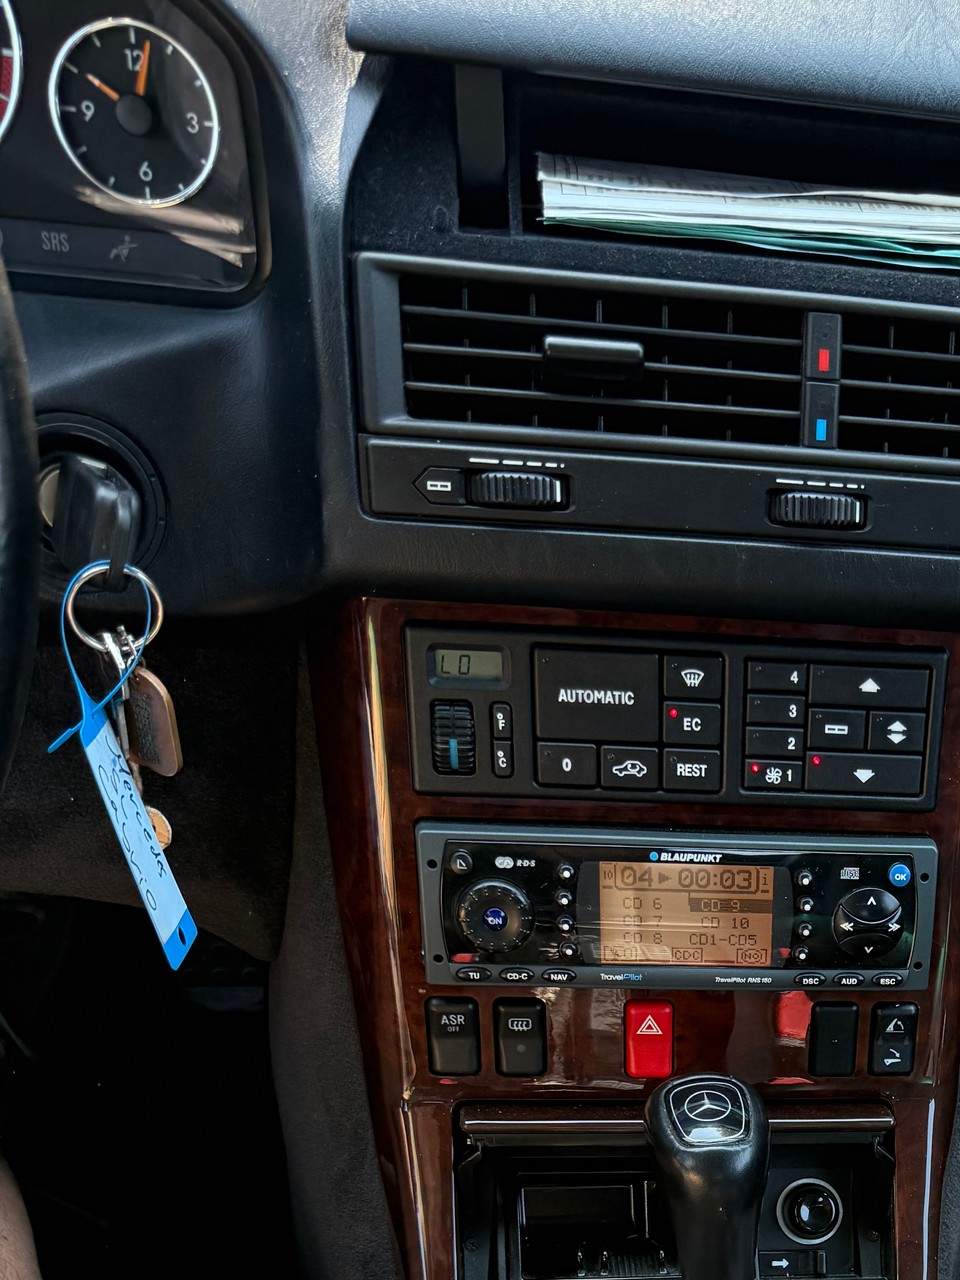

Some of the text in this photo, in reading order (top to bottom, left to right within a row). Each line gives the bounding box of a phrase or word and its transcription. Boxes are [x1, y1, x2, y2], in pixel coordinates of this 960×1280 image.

[124, 49, 144, 71] 12
[81, 100, 95, 122] 9
[186, 112, 200, 134] 3
[139, 161, 152, 182] 6
[42, 231, 70, 252] SRS
[790, 671, 798, 684] 4
[558, 689, 635, 706] AUTOMATIC
[789, 704, 797, 717] 3
[684, 718, 701, 731] EC
[788, 737, 795, 750] 2
[562, 758, 571, 772] 0
[676, 762, 707, 778] REST
[786, 770, 792, 782] 1
[106, 736, 167, 877] Mercedes
[660, 852, 722, 862] BLAUPUNKT
[620, 866, 752, 890] 04 00:03
[623, 897, 662, 910] CD 6
[488, 917, 502, 925] ON
[623, 915, 662, 927] CD 7
[701, 917, 750, 929] CD 10
[624, 932, 662, 944] CD 8
[690, 934, 757, 946] CD1-CD5
[674, 951, 700, 960] CDC
[469, 972, 480, 980] TU
[441, 1015, 465, 1025] ASR
